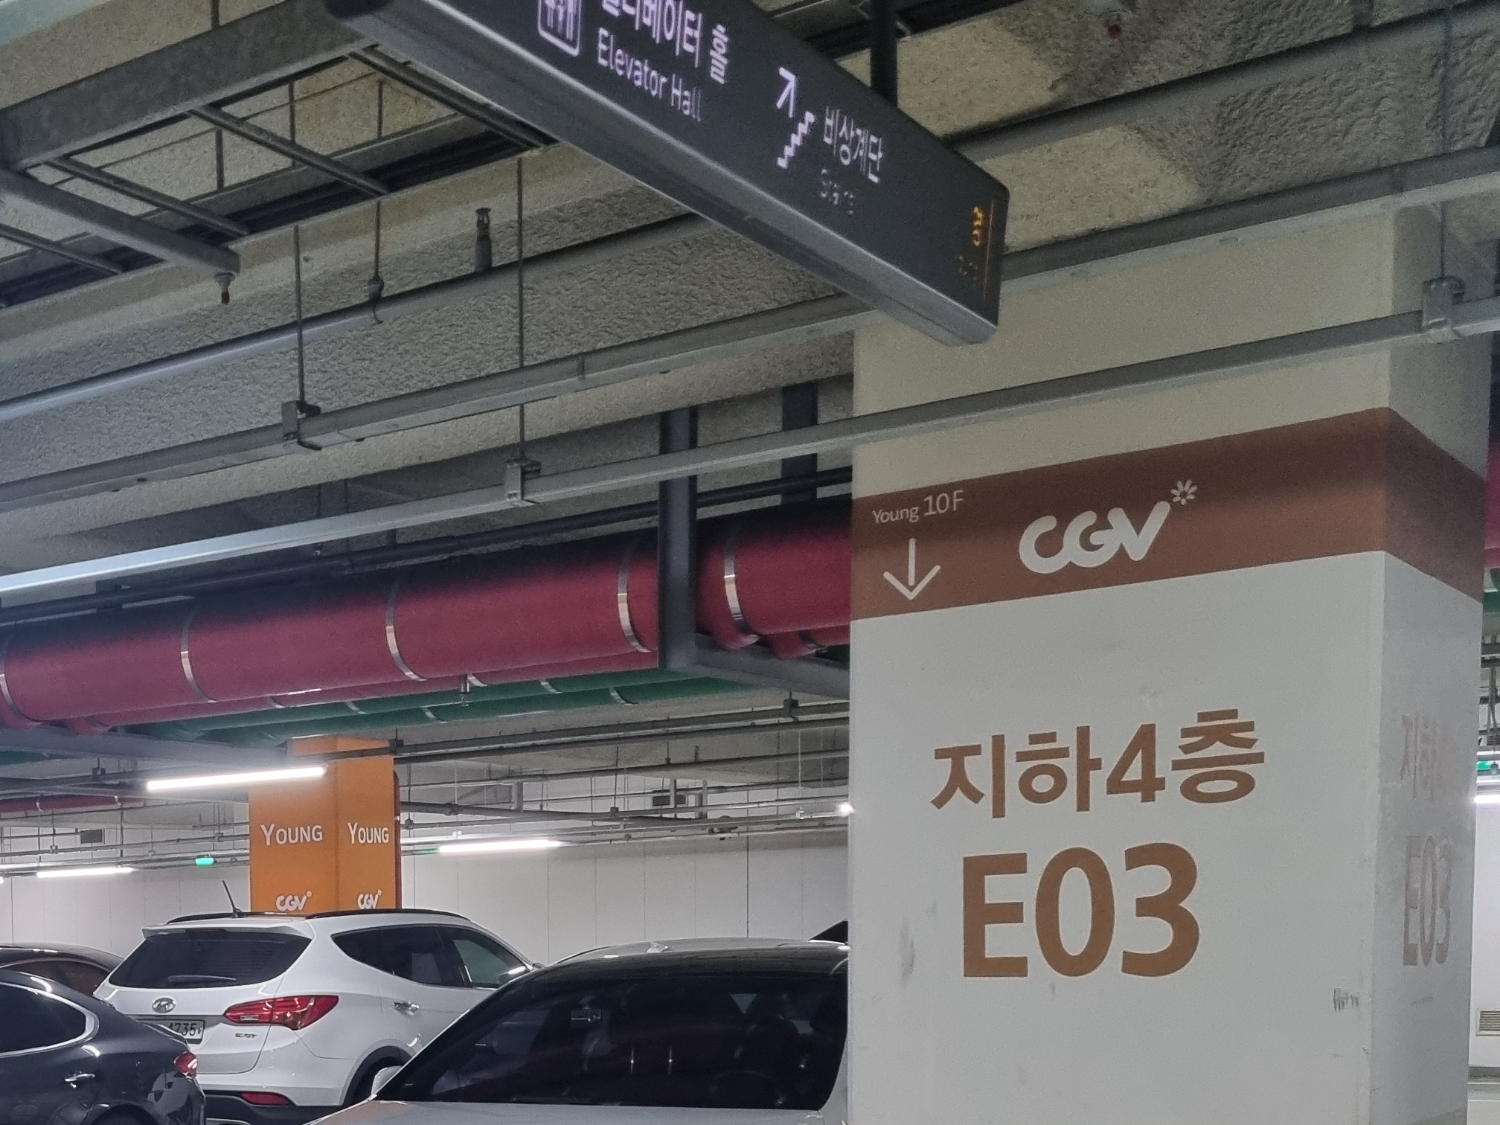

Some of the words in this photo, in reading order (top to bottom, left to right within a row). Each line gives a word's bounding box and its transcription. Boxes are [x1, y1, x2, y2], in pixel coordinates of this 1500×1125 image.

[598, 27, 668, 99] Elevator
[671, 73, 702, 122] Hall
[823, 106, 884, 185] 비상계단
[871, 506, 920, 525] Young
[923, 489, 965, 517] 10F
[1018, 500, 1172, 574] CGV
[930, 708, 1266, 819] 지하4층
[275, 894, 307, 912] CGV
[357, 893, 379, 910] CGV
[961, 842, 1201, 978] E03
